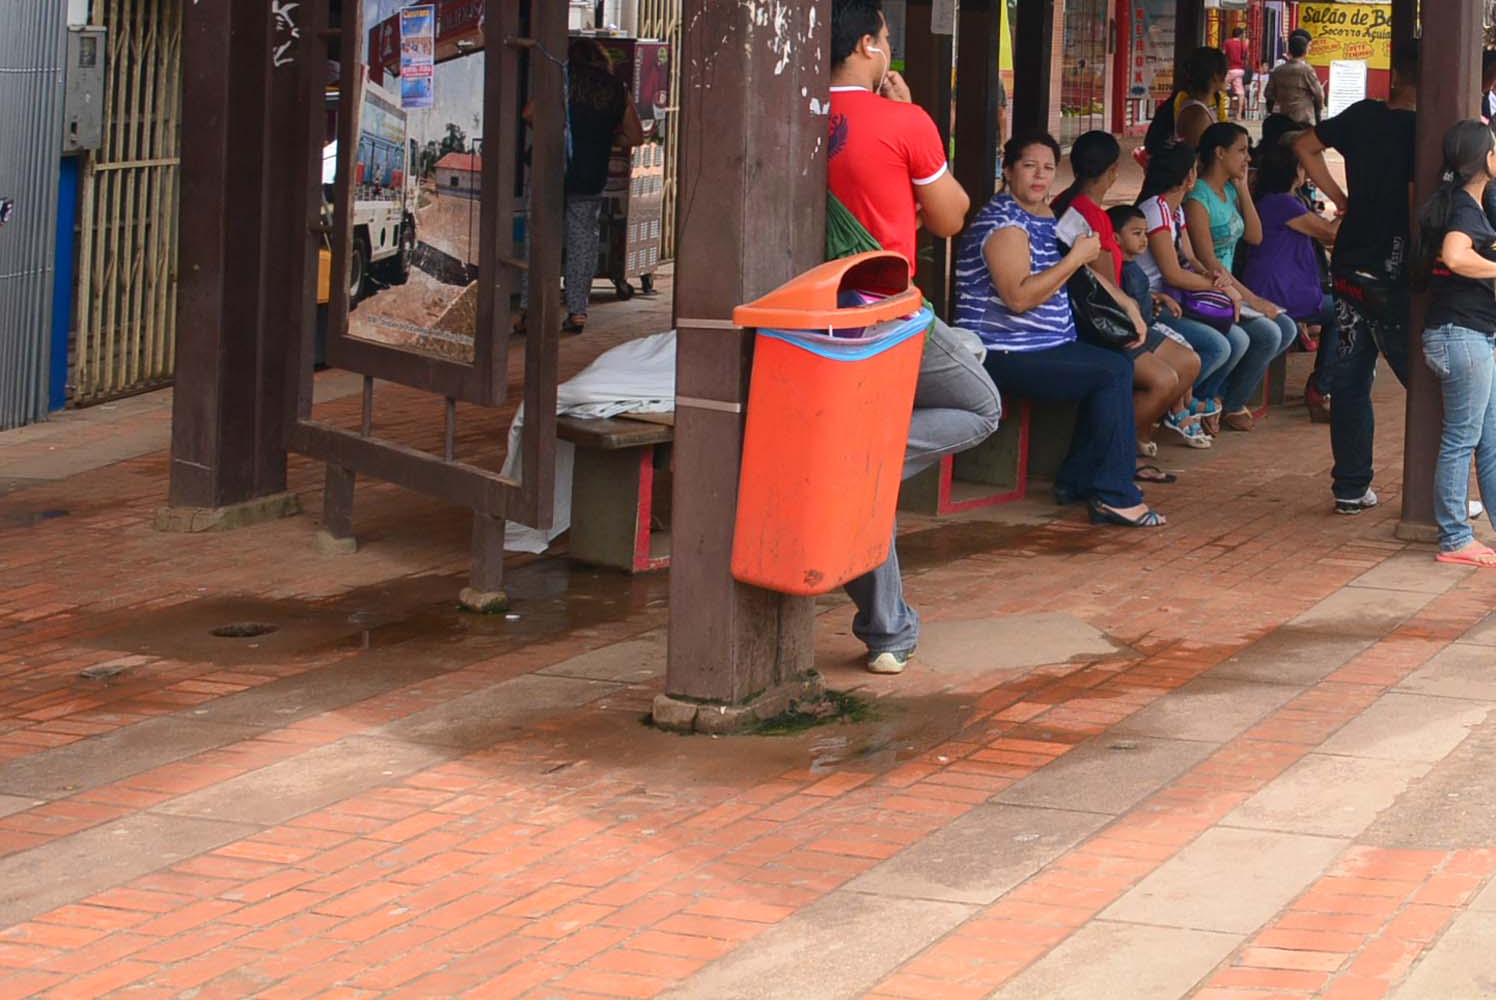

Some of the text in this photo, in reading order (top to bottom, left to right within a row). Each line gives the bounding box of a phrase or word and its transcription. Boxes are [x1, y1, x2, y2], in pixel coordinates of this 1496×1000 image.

[1302, 6, 1348, 25] Salão
[1350, 8, 1369, 26] de
[1319, 25, 1361, 38] Socorro
